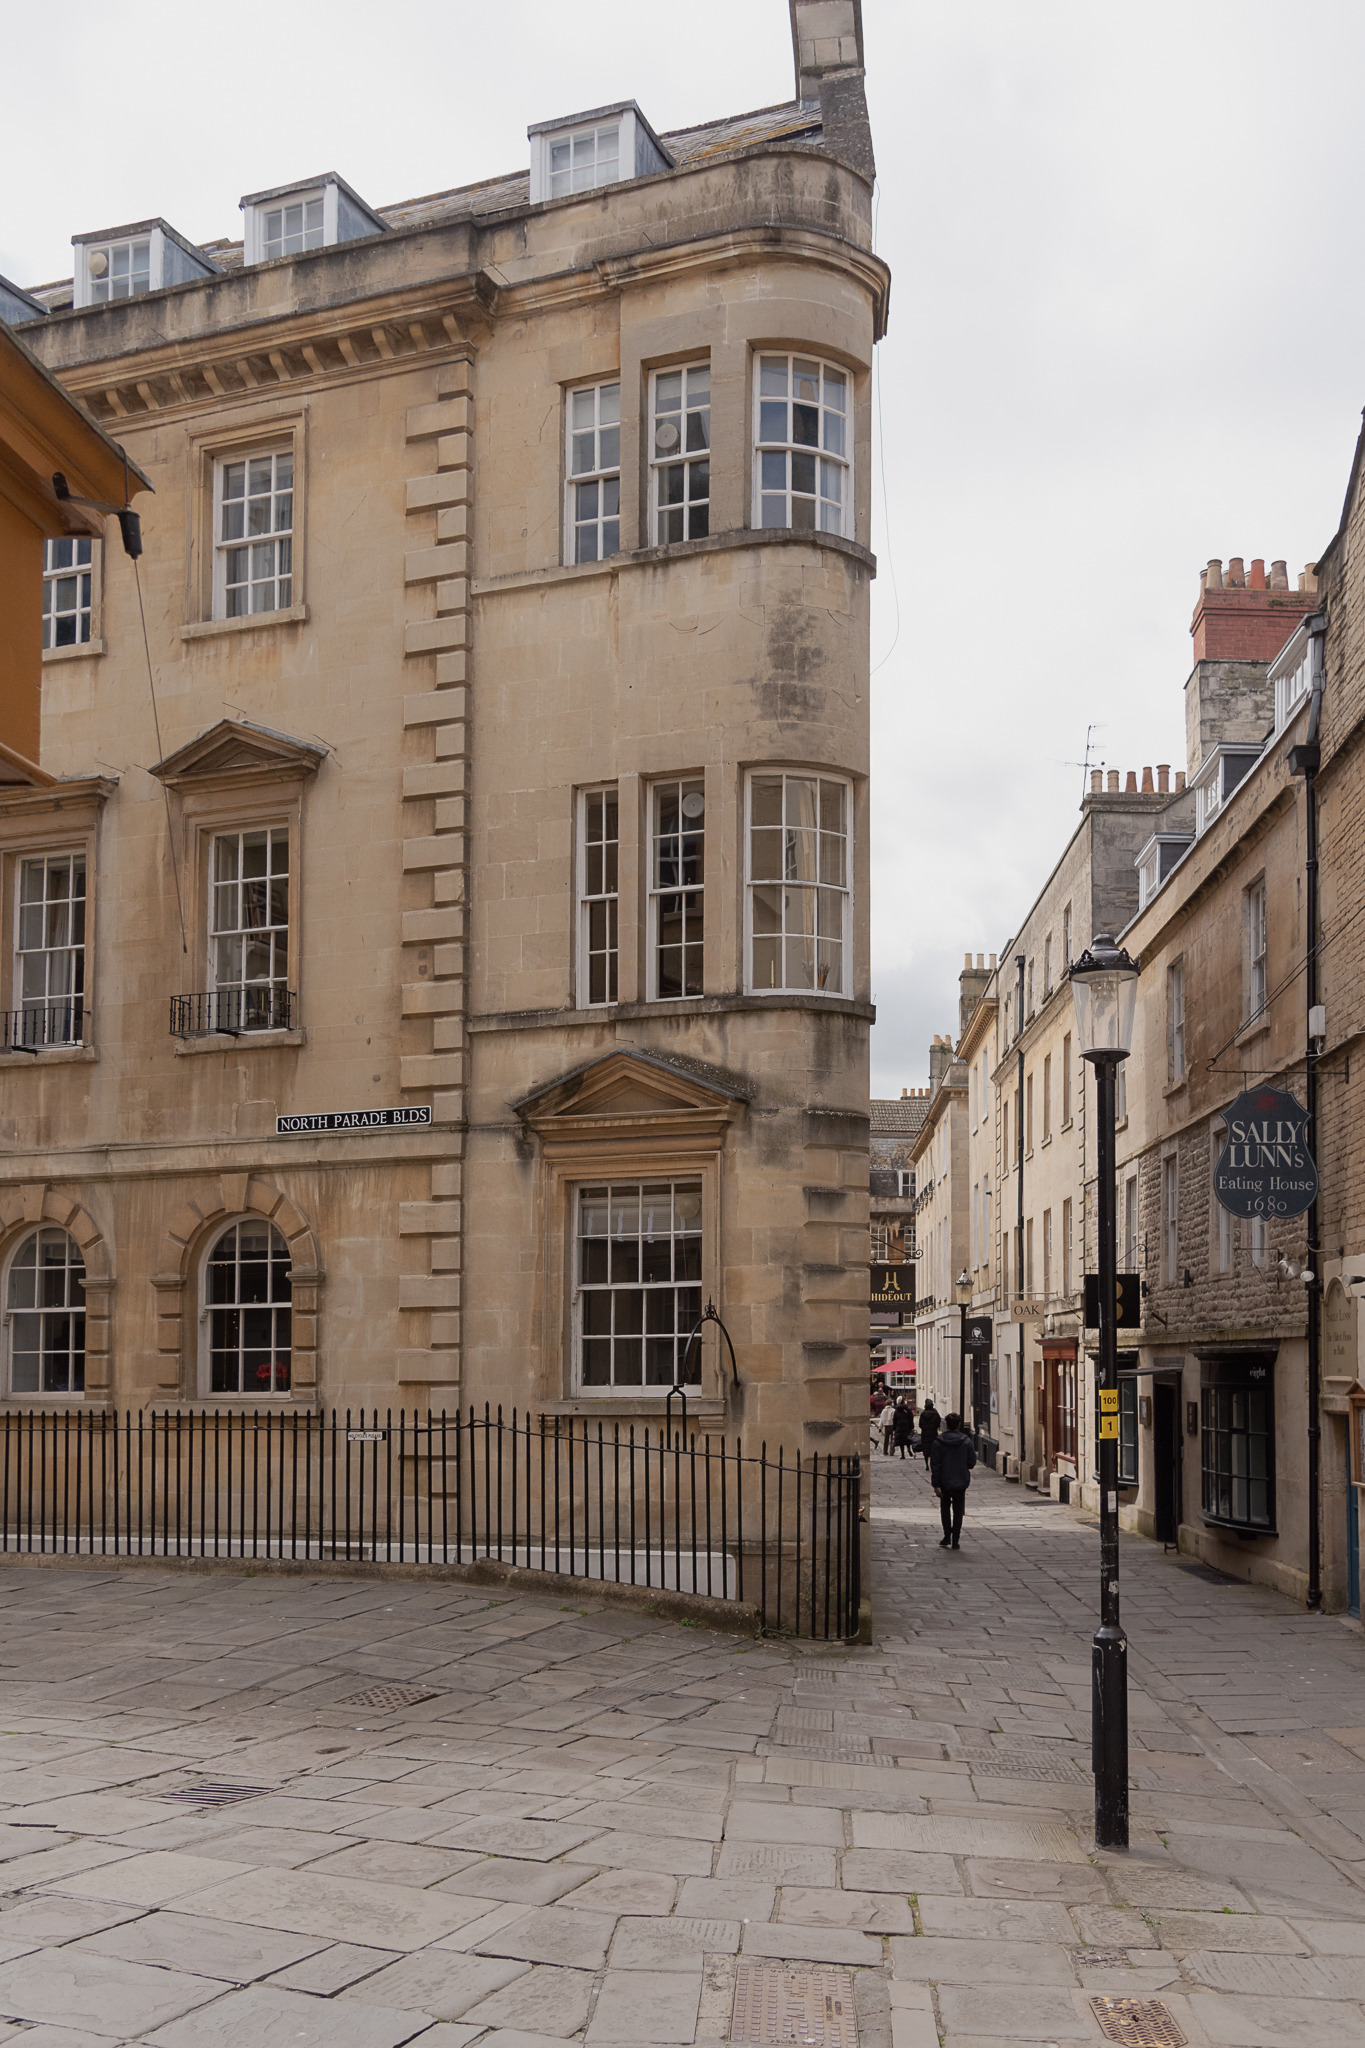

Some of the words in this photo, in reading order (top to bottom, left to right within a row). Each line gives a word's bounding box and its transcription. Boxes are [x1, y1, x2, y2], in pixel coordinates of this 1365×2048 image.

[280, 1117, 328, 1131] NORTH
[334, 1111, 388, 1128] PARADE
[393, 1108, 427, 1123] BLDS
[1231, 1120, 1302, 1144] SALLY
[1228, 1144, 1305, 1168] LUNN's
[1218, 1175, 1264, 1193] Eating
[1270, 1176, 1314, 1191] House
[1246, 1195, 1287, 1212] 1680
[871, 1292, 912, 1302] HIDEOUT
[1013, 1304, 1041, 1316] OAK
[1249, 1366, 1266, 1379] eight
[1103, 1396, 1117, 1405] 100
[1107, 1421, 1113, 1432] 1
